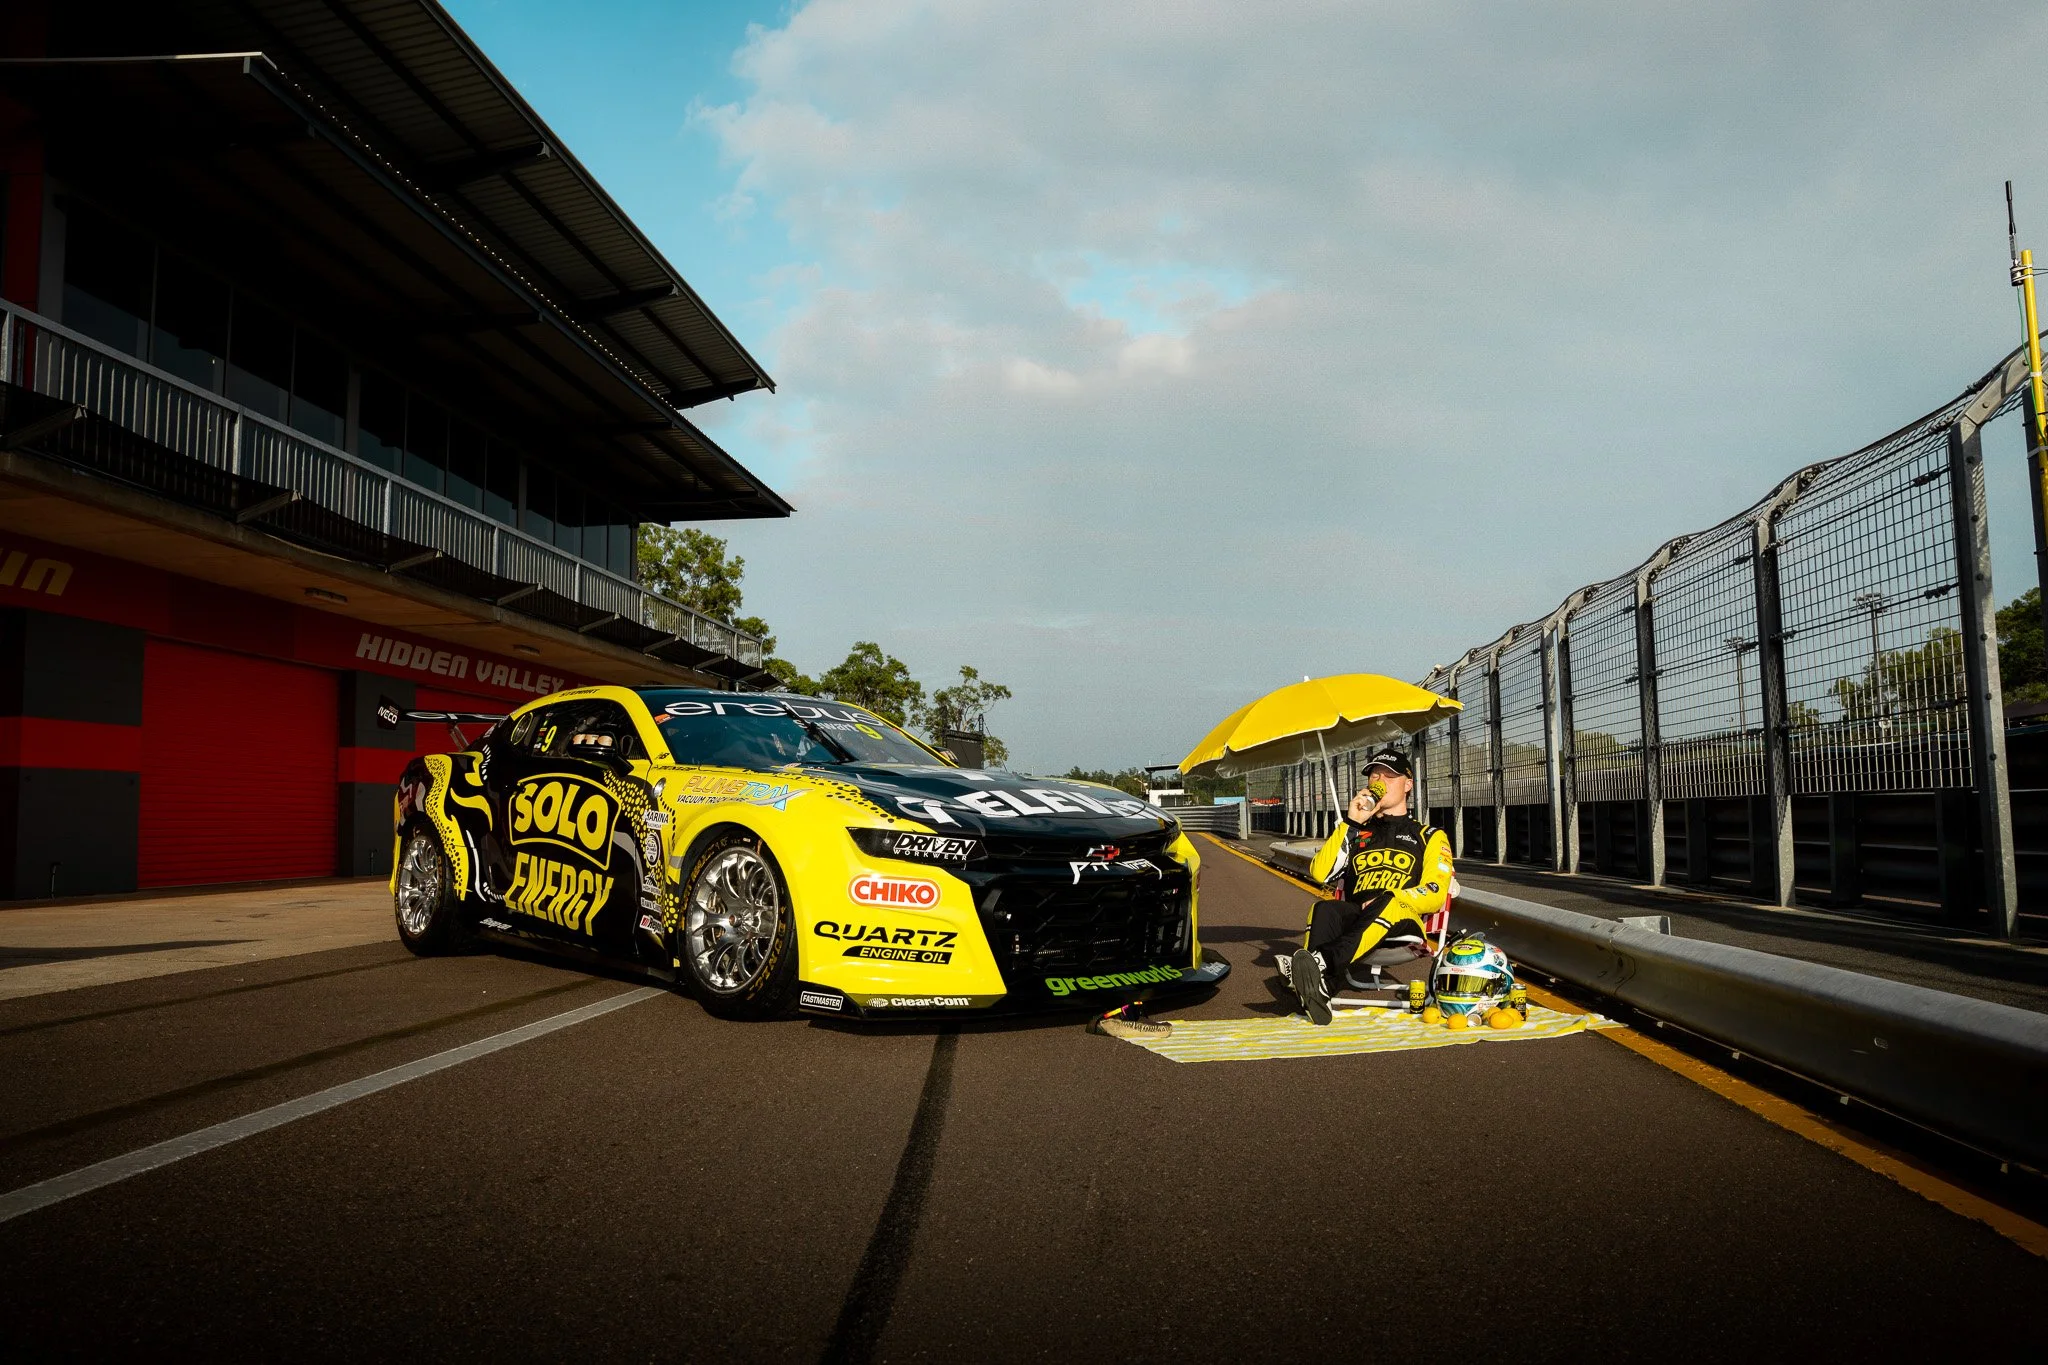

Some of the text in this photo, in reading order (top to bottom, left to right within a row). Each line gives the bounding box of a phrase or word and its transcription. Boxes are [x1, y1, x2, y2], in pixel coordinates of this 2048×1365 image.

[355, 633, 565, 695] HIDDEN VALLEY
[378, 706, 398, 724] IVECO
[664, 701, 884, 728] erebus
[541, 725, 558, 752] 9
[854, 723, 884, 740] 9
[677, 795, 706, 803] VACUUM
[513, 781, 609, 850] SOLO
[893, 848, 967, 861] WORKWEAR
[897, 833, 976, 856] DRIVEN
[1355, 850, 1411, 871] SOLO
[504, 851, 615, 937] ENERGY
[854, 880, 935, 905] CHIKO
[1353, 869, 1412, 895] ENERGY
[813, 920, 958, 949] QUARTZ
[859, 946, 947, 963] ENGINE OIL
[1045, 964, 1183, 996] greenworks
[802, 994, 841, 1008] FASTMASTER
[890, 997, 969, 1007] Clear-Com
